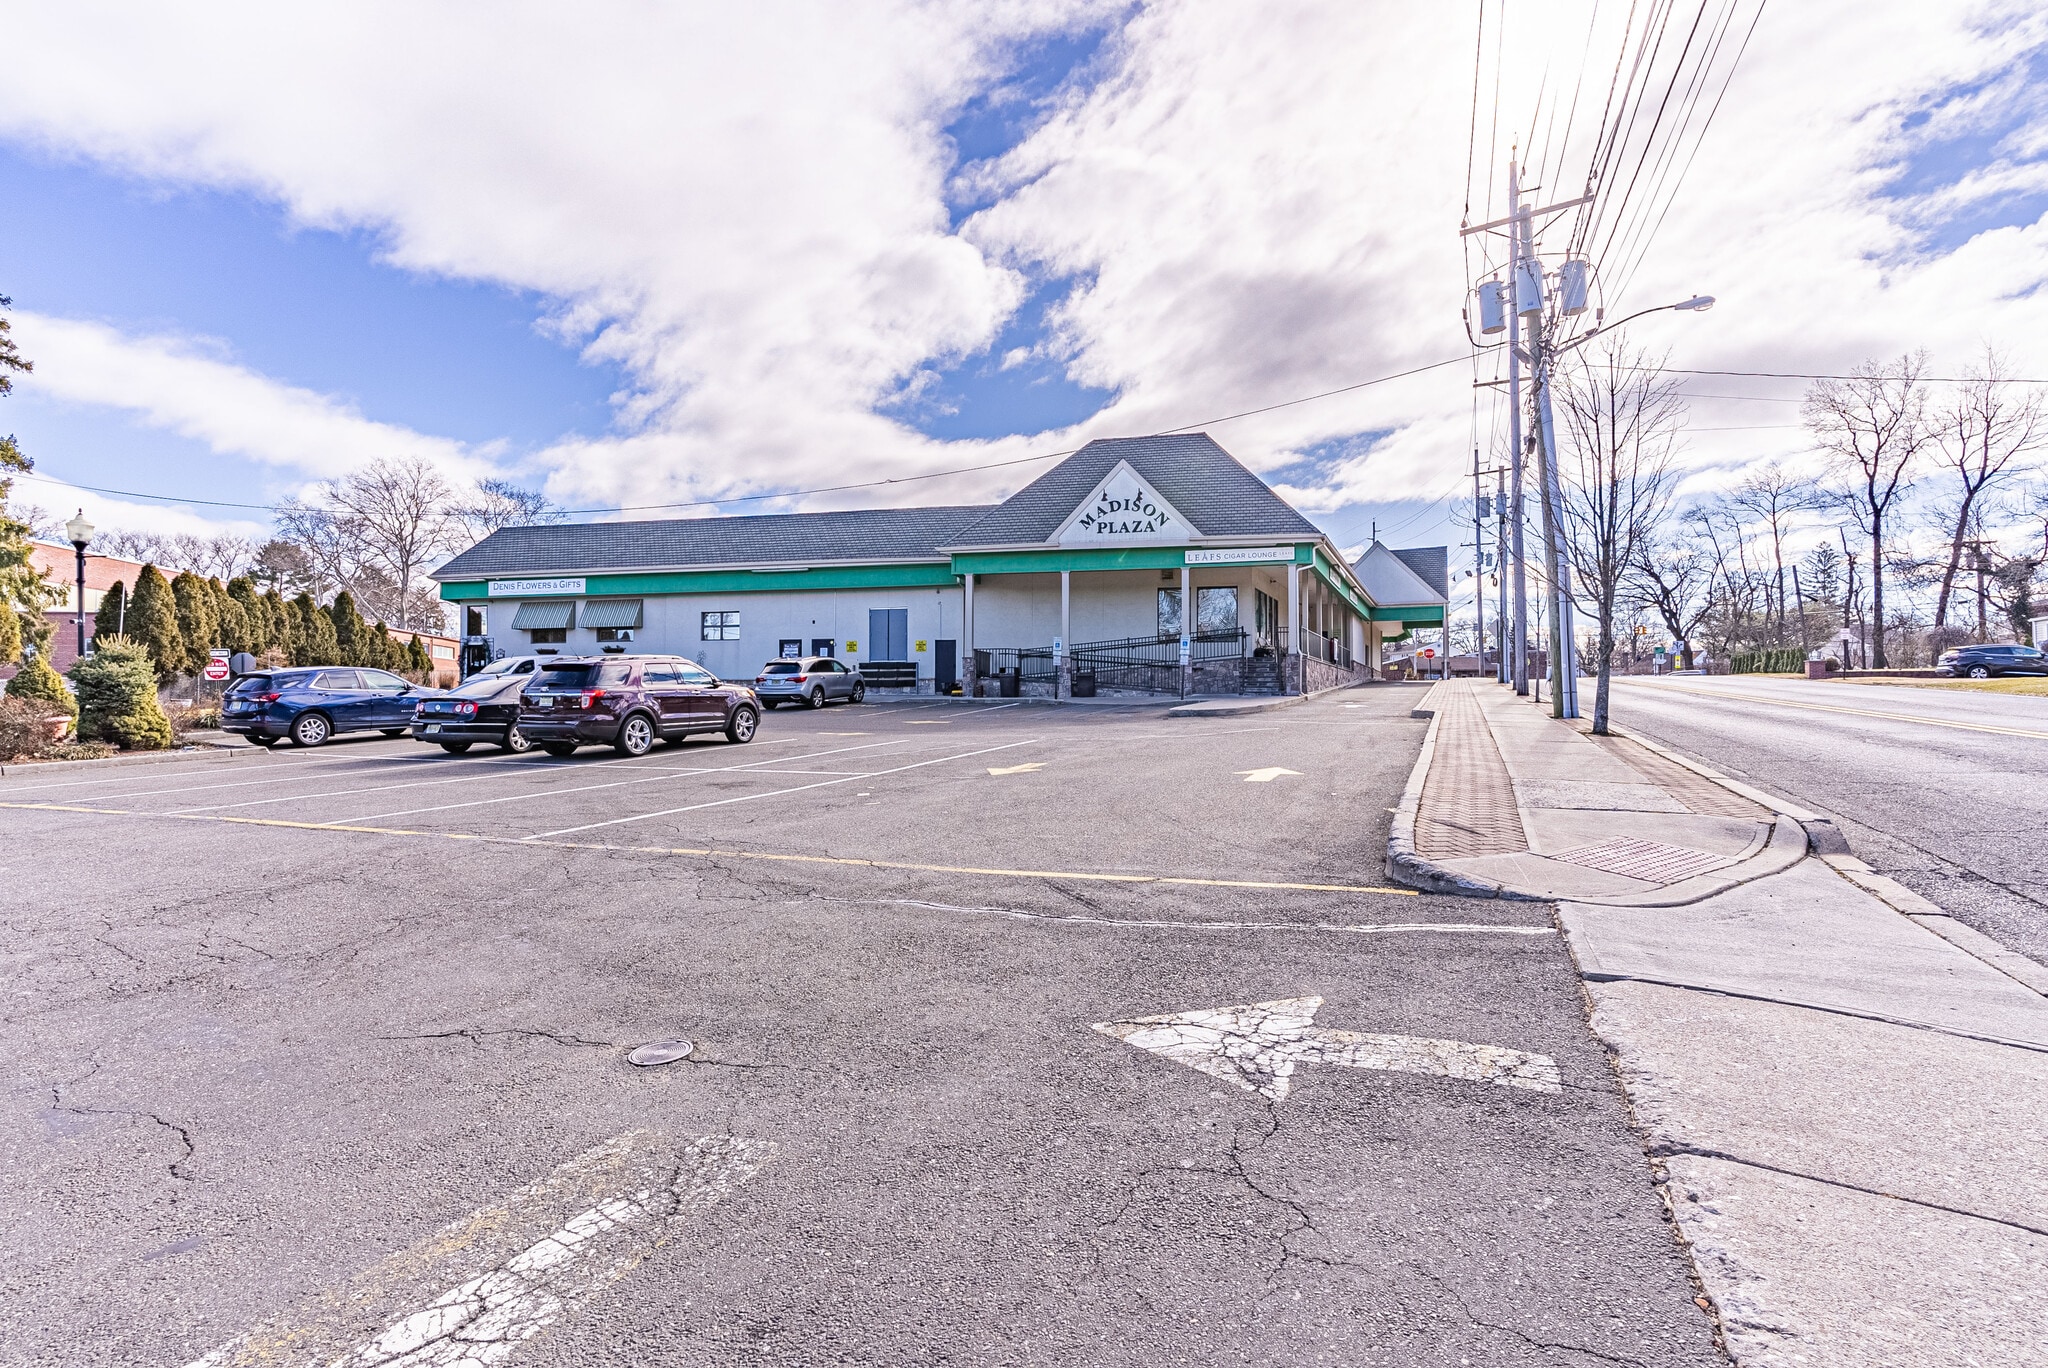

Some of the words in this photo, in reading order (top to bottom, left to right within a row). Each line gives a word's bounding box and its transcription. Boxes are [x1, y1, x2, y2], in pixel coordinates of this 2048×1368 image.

[1079, 499, 1170, 530] MADISON
[1097, 520, 1156, 534] PLAZA
[1223, 552, 1246, 560] CIGAR
[1247, 551, 1277, 559] LOUNGE
[493, 582, 516, 591] DENIS
[516, 581, 552, 590] FLOWERS
[559, 580, 581, 589] GIFTS
